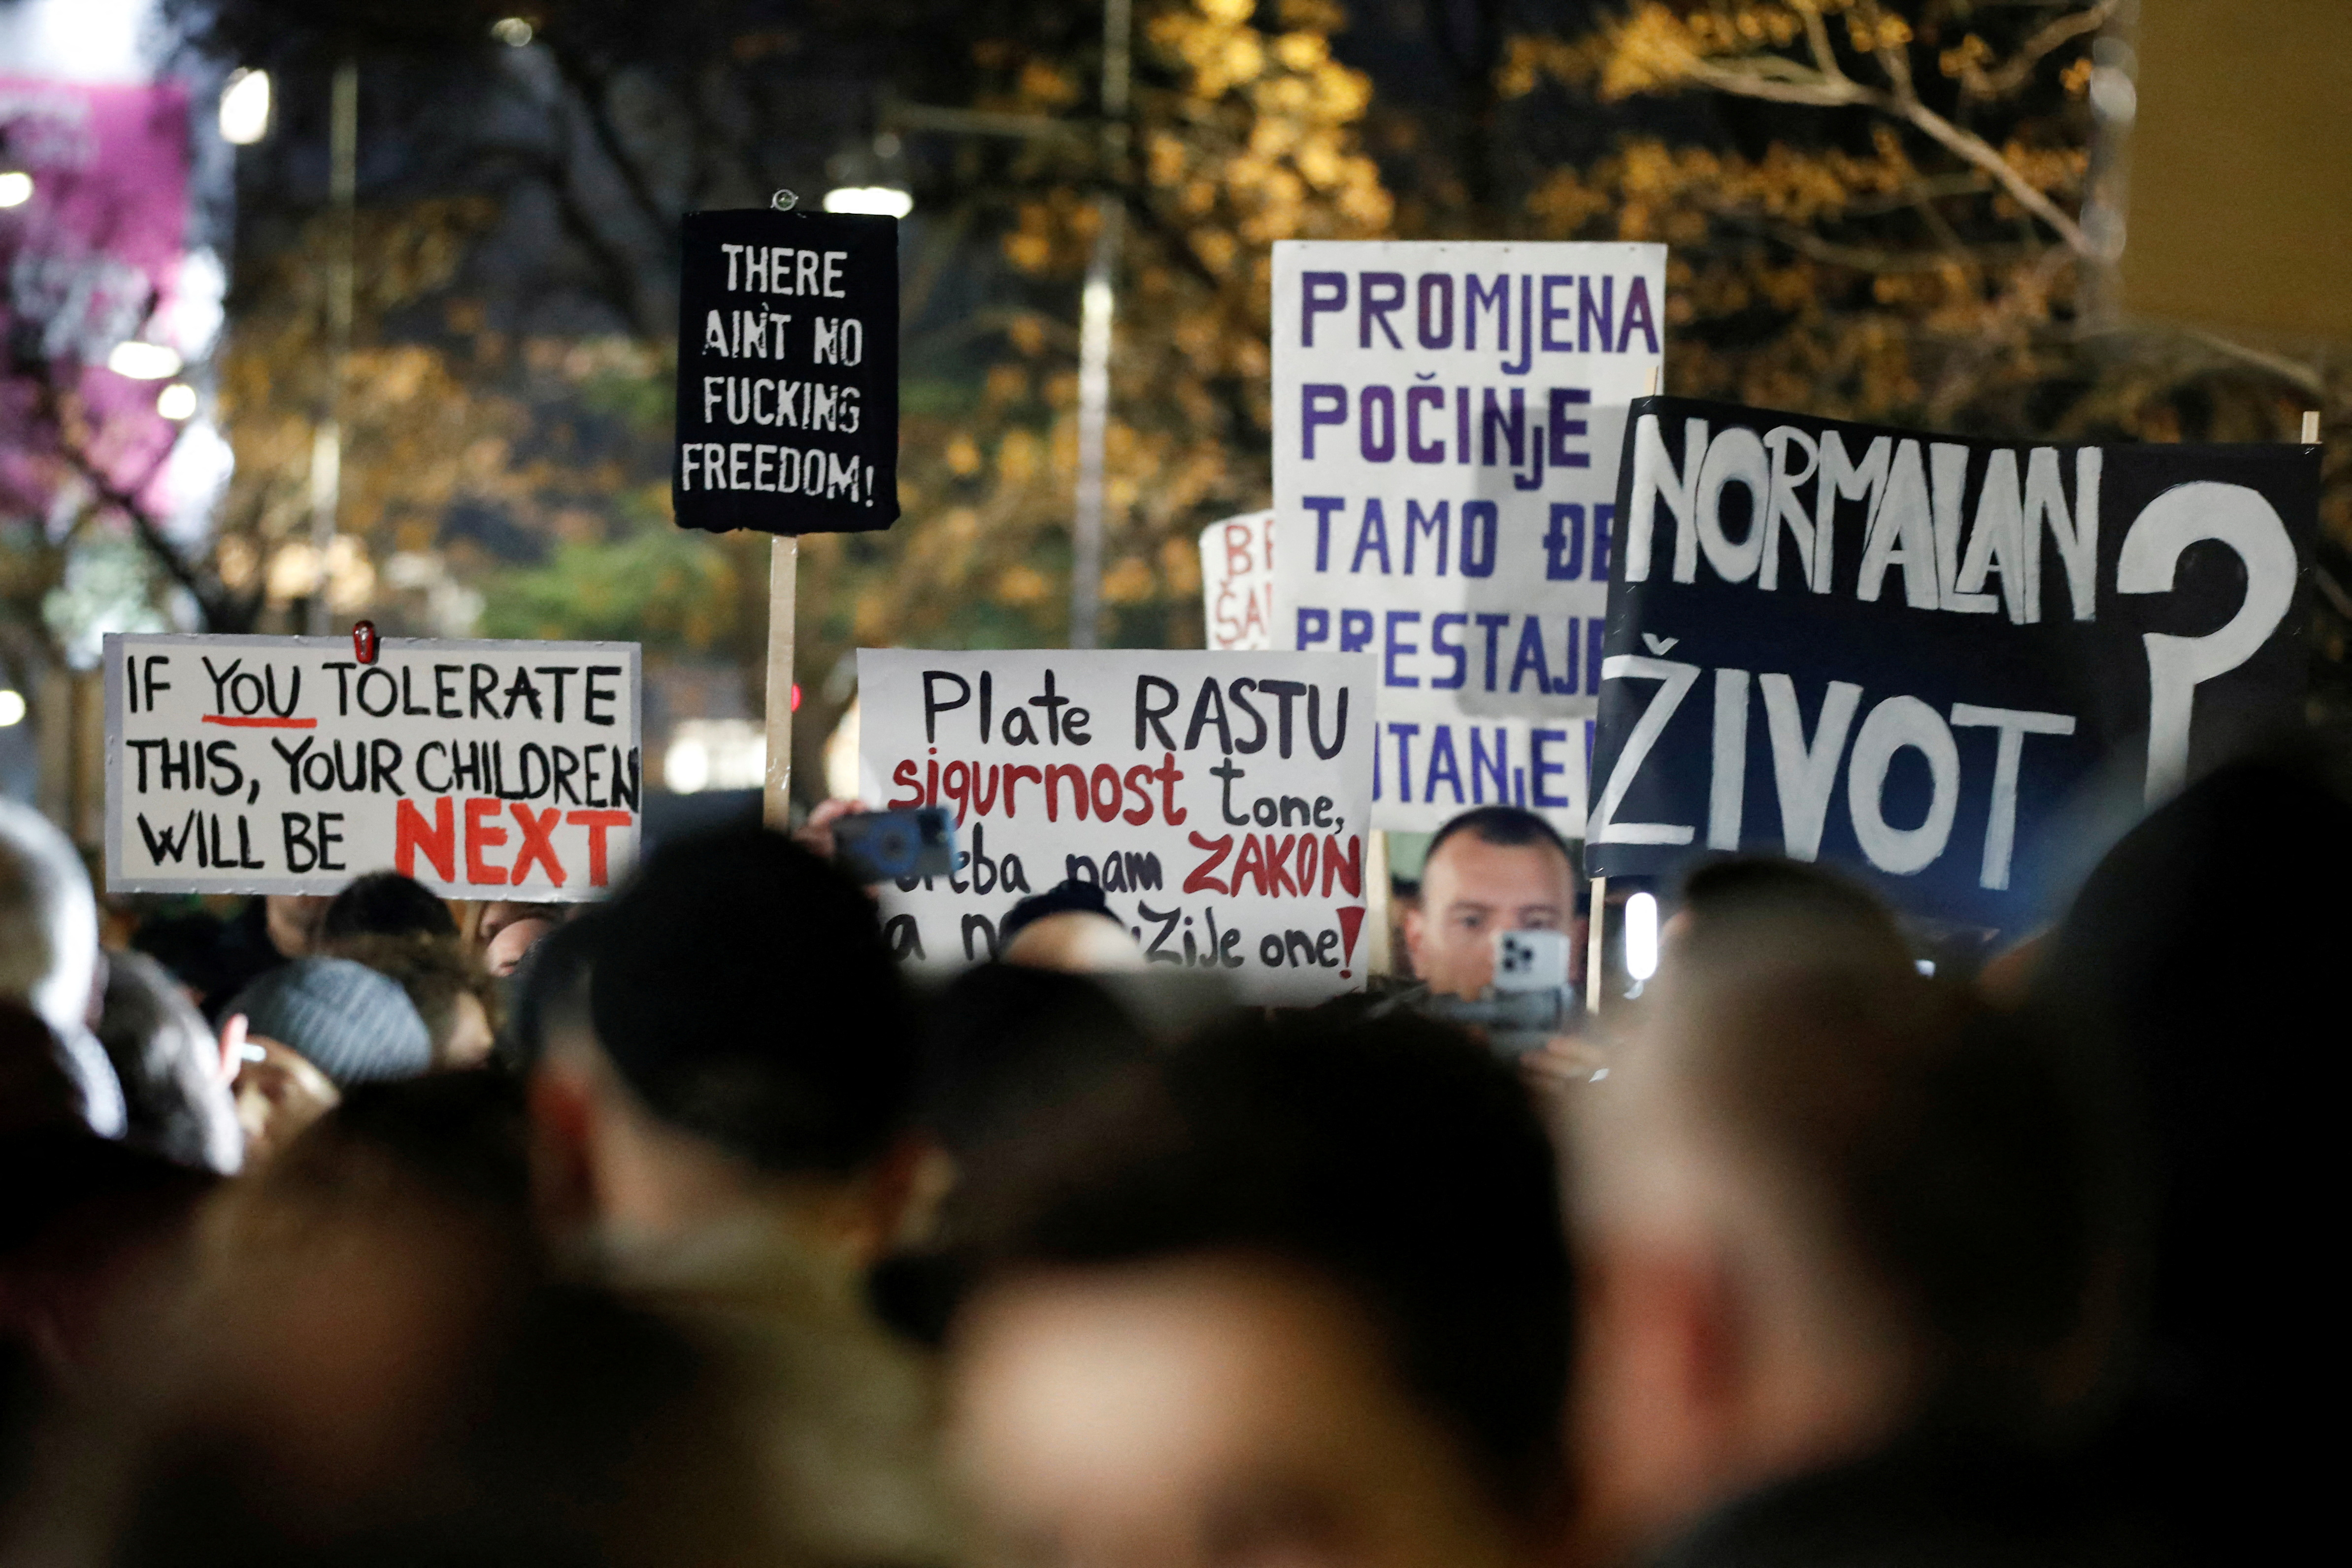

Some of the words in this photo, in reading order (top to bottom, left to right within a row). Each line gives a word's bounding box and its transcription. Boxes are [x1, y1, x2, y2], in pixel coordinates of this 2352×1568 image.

[721, 243, 848, 299] THERE
[814, 316, 862, 367] NO
[1301, 271, 1660, 375] PROMJENA
[704, 376, 860, 434] FUCKING
[1302, 371, 1591, 492] POČINJE
[682, 443, 874, 507] FREEDOM!
[1302, 496, 1499, 579] TAMO
[1624, 414, 2103, 625] NORMALAN
[127, 655, 171, 713] IF
[201, 656, 299, 717] YOU
[322, 662, 623, 726] TOLERATE
[922, 668, 1092, 746] Plate
[1134, 674, 1349, 760] RASTU
[126, 737, 260, 805] THIS,
[271, 735, 406, 797] YOUR
[415, 739, 639, 813] CHILDREN
[887, 748, 1187, 830] sigurnost
[1209, 757, 1345, 835] tone,
[1586, 633, 2076, 890] ŽIVOT
[136, 809, 265, 869] WILL
[281, 811, 346, 872] BE
[394, 796, 632, 888] NEXT
[1065, 850, 1163, 893] nam
[1183, 831, 1360, 898] ZAKON
[961, 913, 1016, 962] n
[1259, 905, 1365, 980] one!
